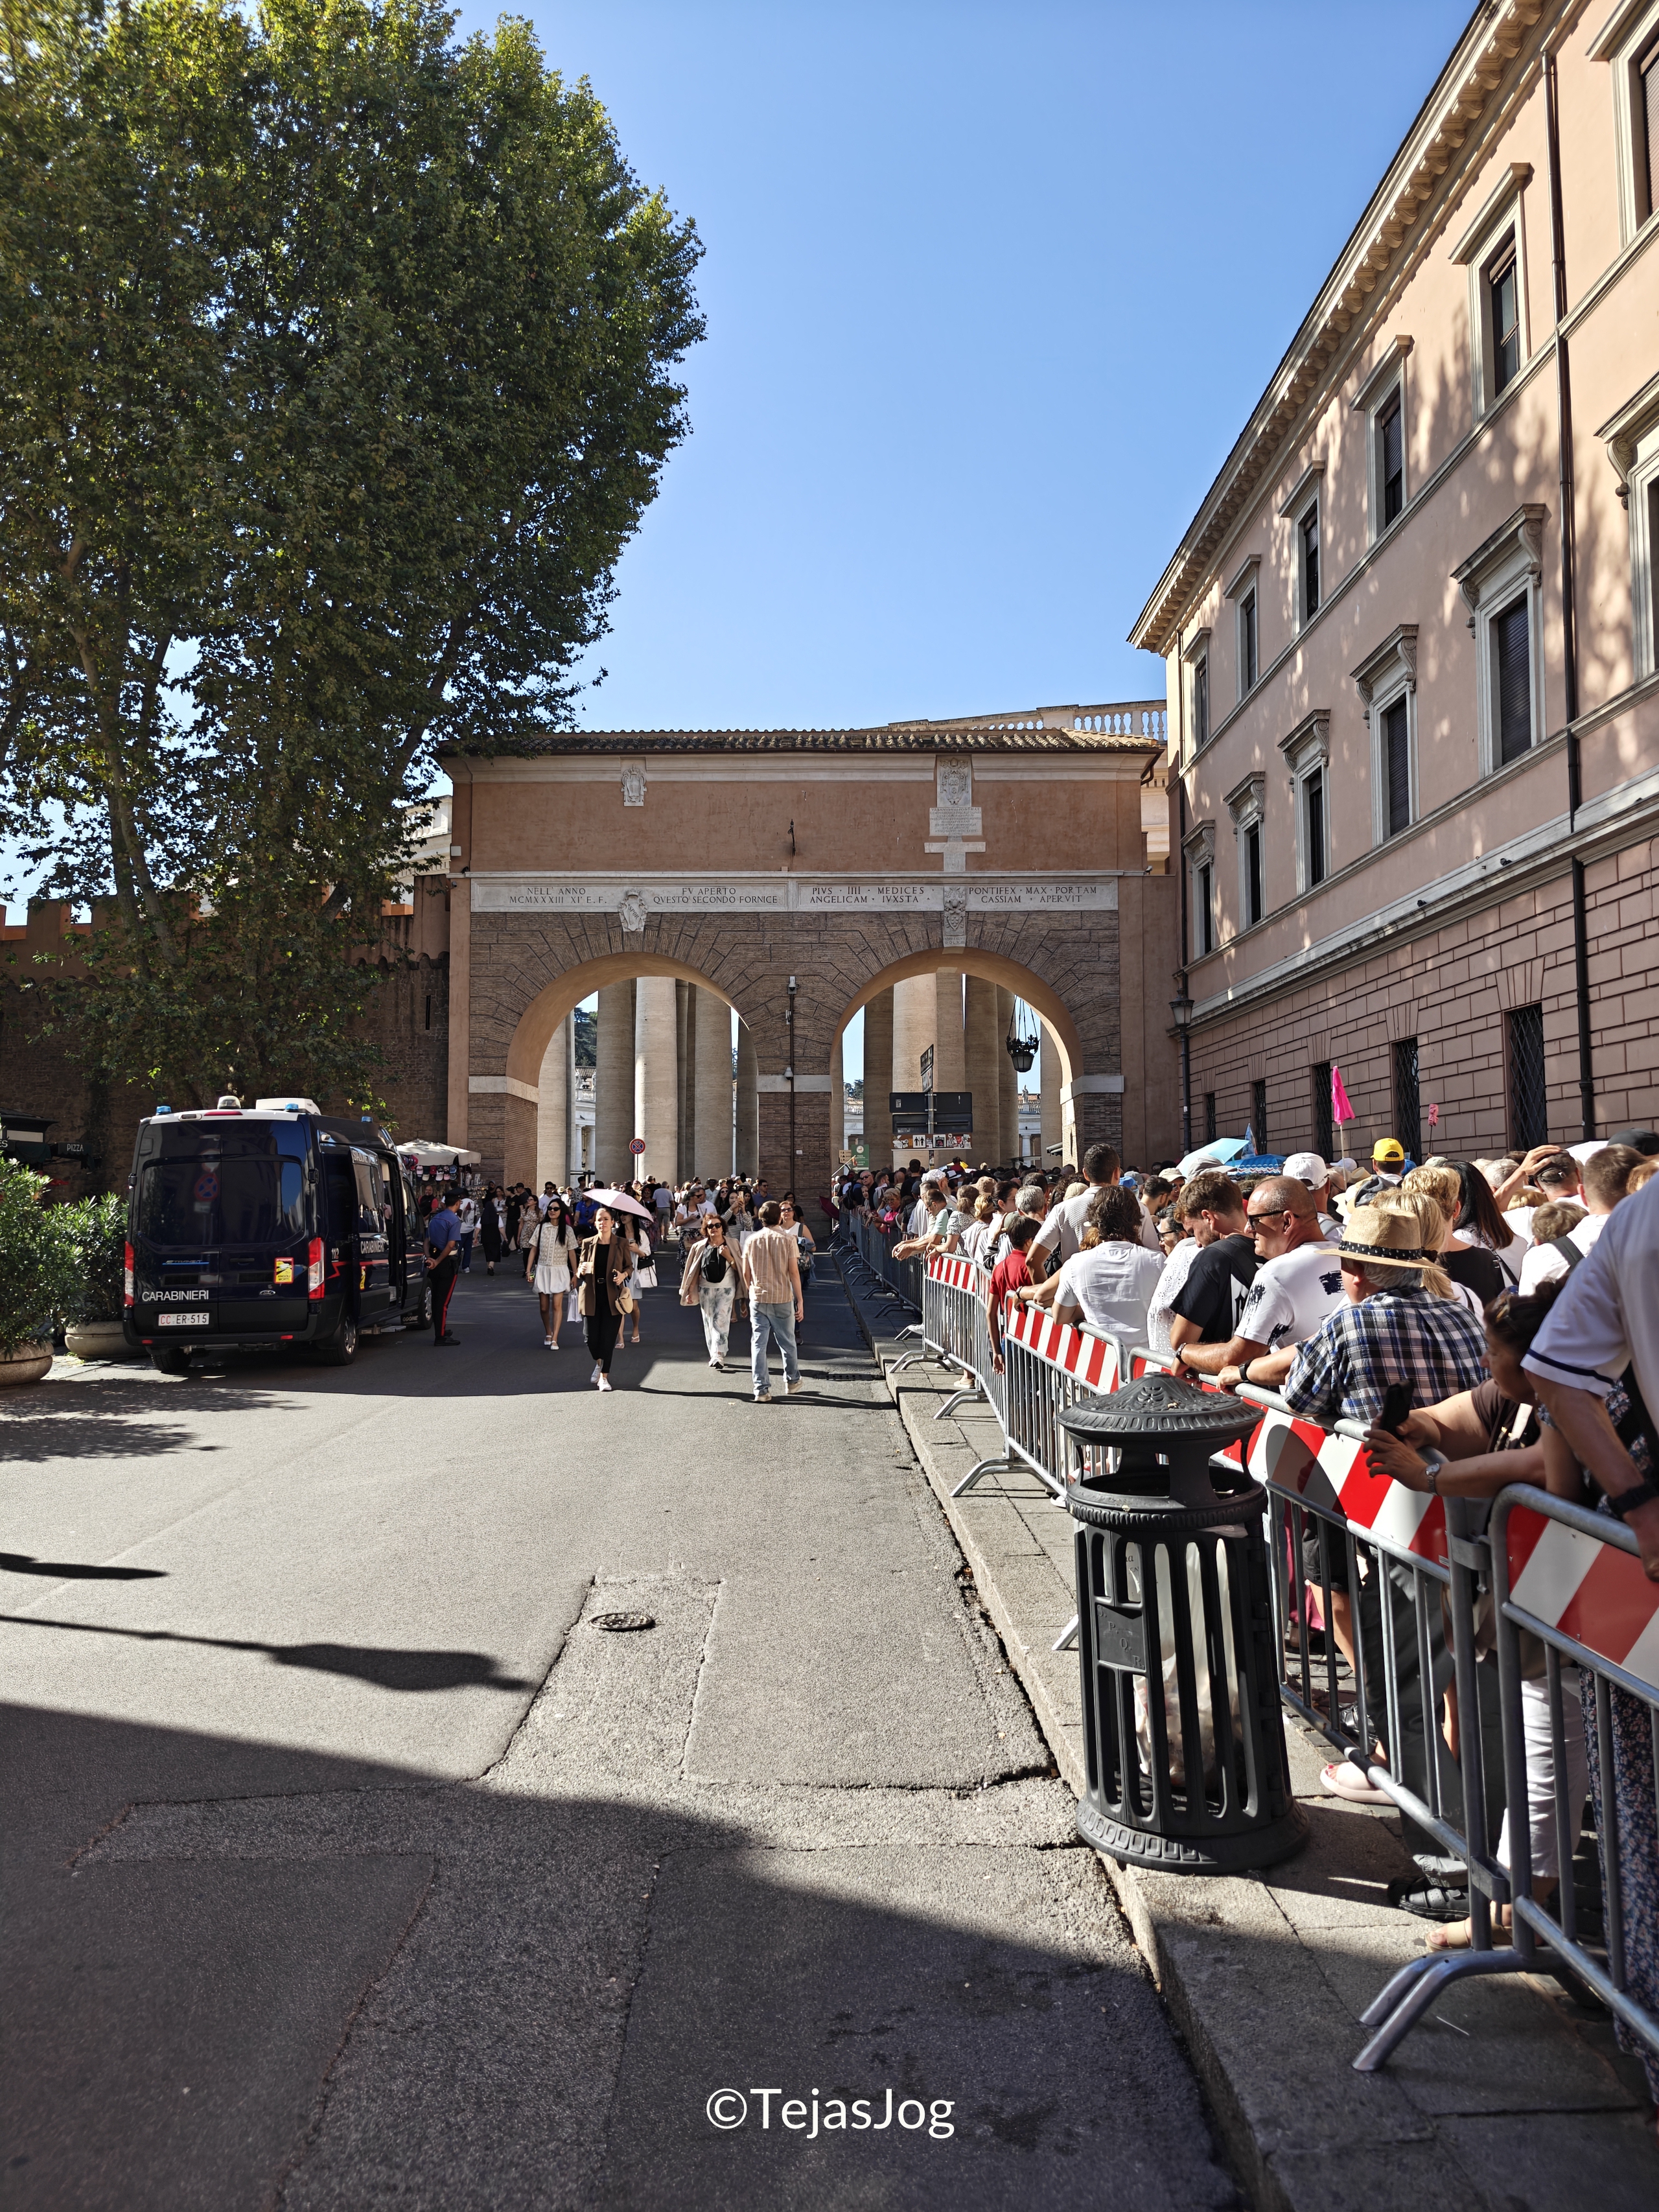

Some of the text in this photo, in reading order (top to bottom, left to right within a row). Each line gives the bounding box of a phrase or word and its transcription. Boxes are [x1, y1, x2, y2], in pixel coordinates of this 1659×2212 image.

[812, 887, 833, 895] PIVS
[848, 886, 861, 894] IIII
[653, 896, 689, 905] QVESTO
[331, 1248, 340, 1259] 112
[142, 1290, 209, 1301] CARABINIERI
[160, 1314, 207, 1324] CC ER 515
